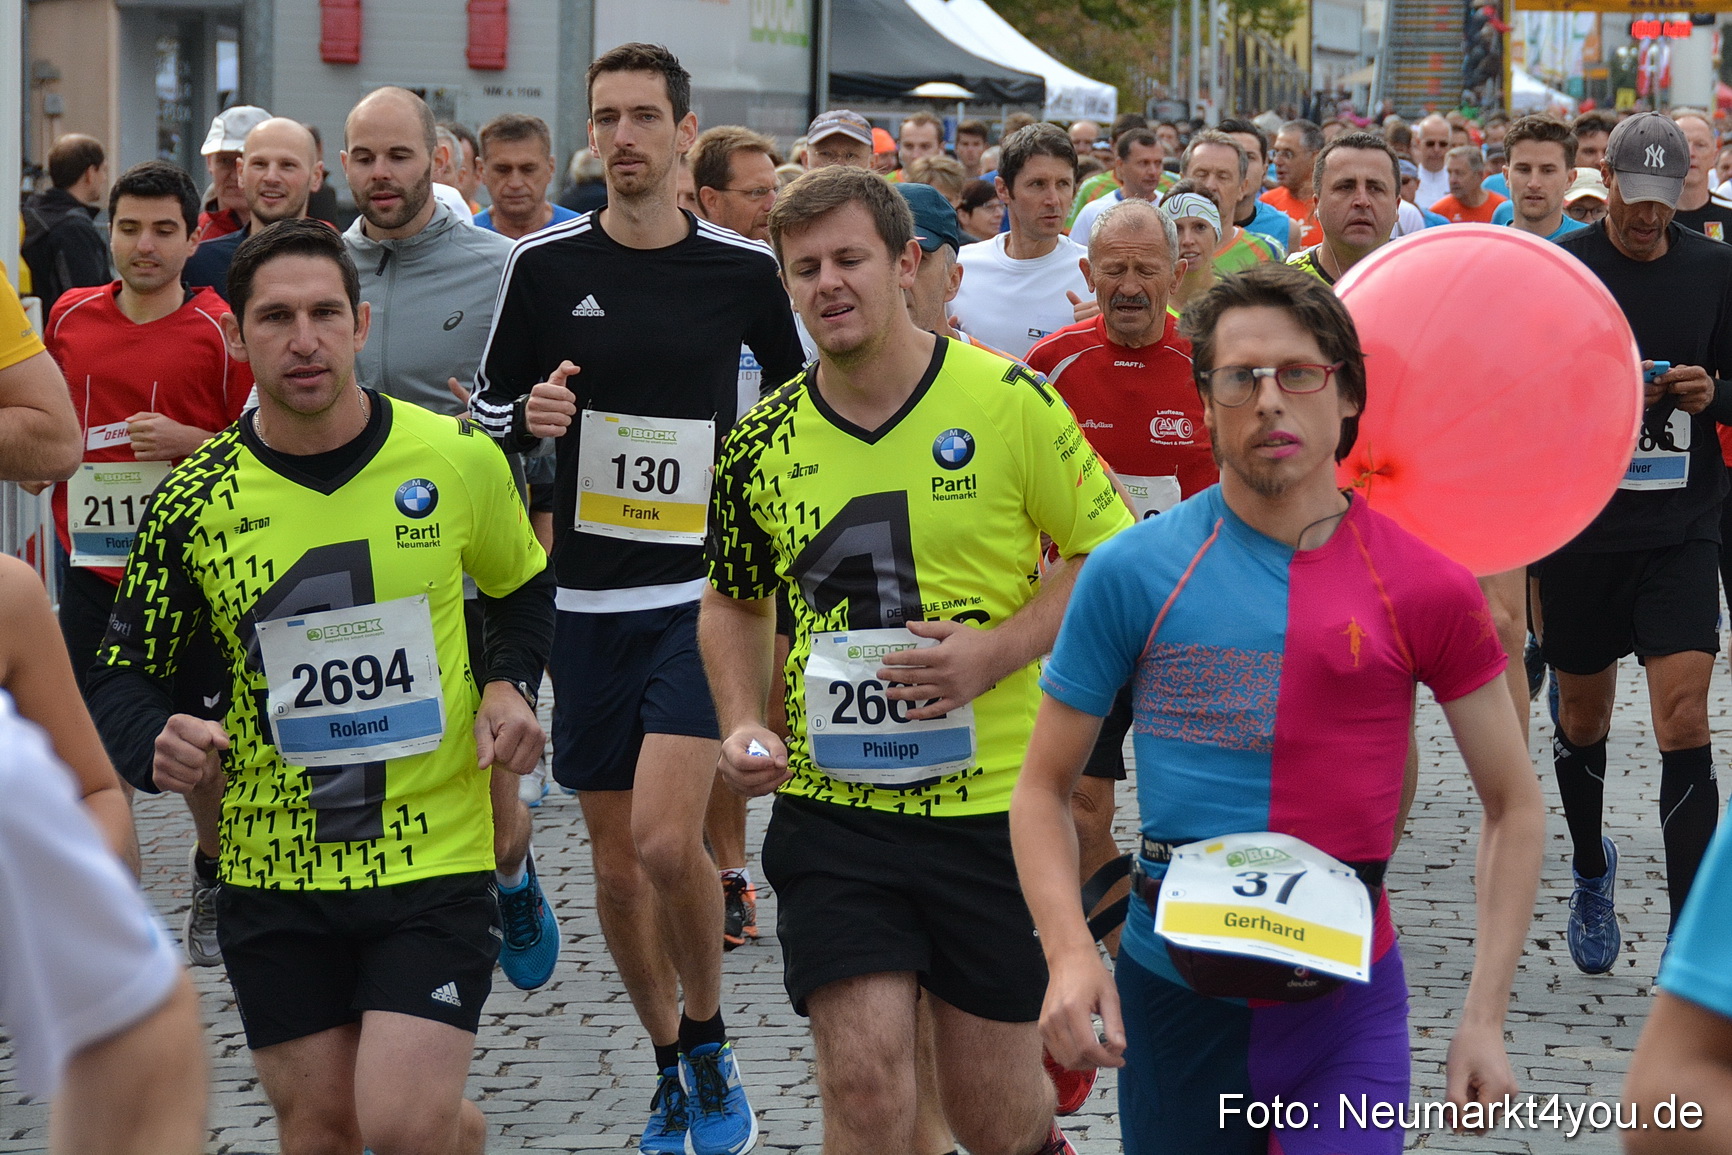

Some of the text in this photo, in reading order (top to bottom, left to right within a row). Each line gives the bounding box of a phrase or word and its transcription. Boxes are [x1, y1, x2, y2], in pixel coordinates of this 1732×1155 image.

[1643, 143, 1666, 169] NY
[571, 309, 606, 317] adidas
[1113, 360, 1139, 368] CRAFT
[631, 428, 677, 441] BOCK
[936, 429, 972, 444] BMW
[611, 453, 680, 495] 130
[1626, 462, 1652, 473] liver
[103, 472, 141, 481] BOCK
[584, 479, 590, 487] C
[931, 474, 977, 493] Partl
[398, 479, 435, 494] BMW
[932, 491, 977, 502] Neumarkt
[623, 504, 660, 520] Frank
[1087, 509, 1101, 521] 100
[395, 523, 440, 541] Partl
[396, 540, 441, 549] Neumarkt
[910, 601, 940, 615] NEUE
[941, 597, 967, 610] BMW
[324, 617, 384, 639] BOCK
[292, 647, 414, 709] 2694
[278, 705, 285, 715] D
[329, 715, 389, 738] Roland
[815, 718, 822, 728] D
[863, 742, 919, 760] Philipp
[1232, 870, 1308, 905] 37
[1224, 912, 1305, 942] Gerhard
[431, 991, 461, 1007] adidas
